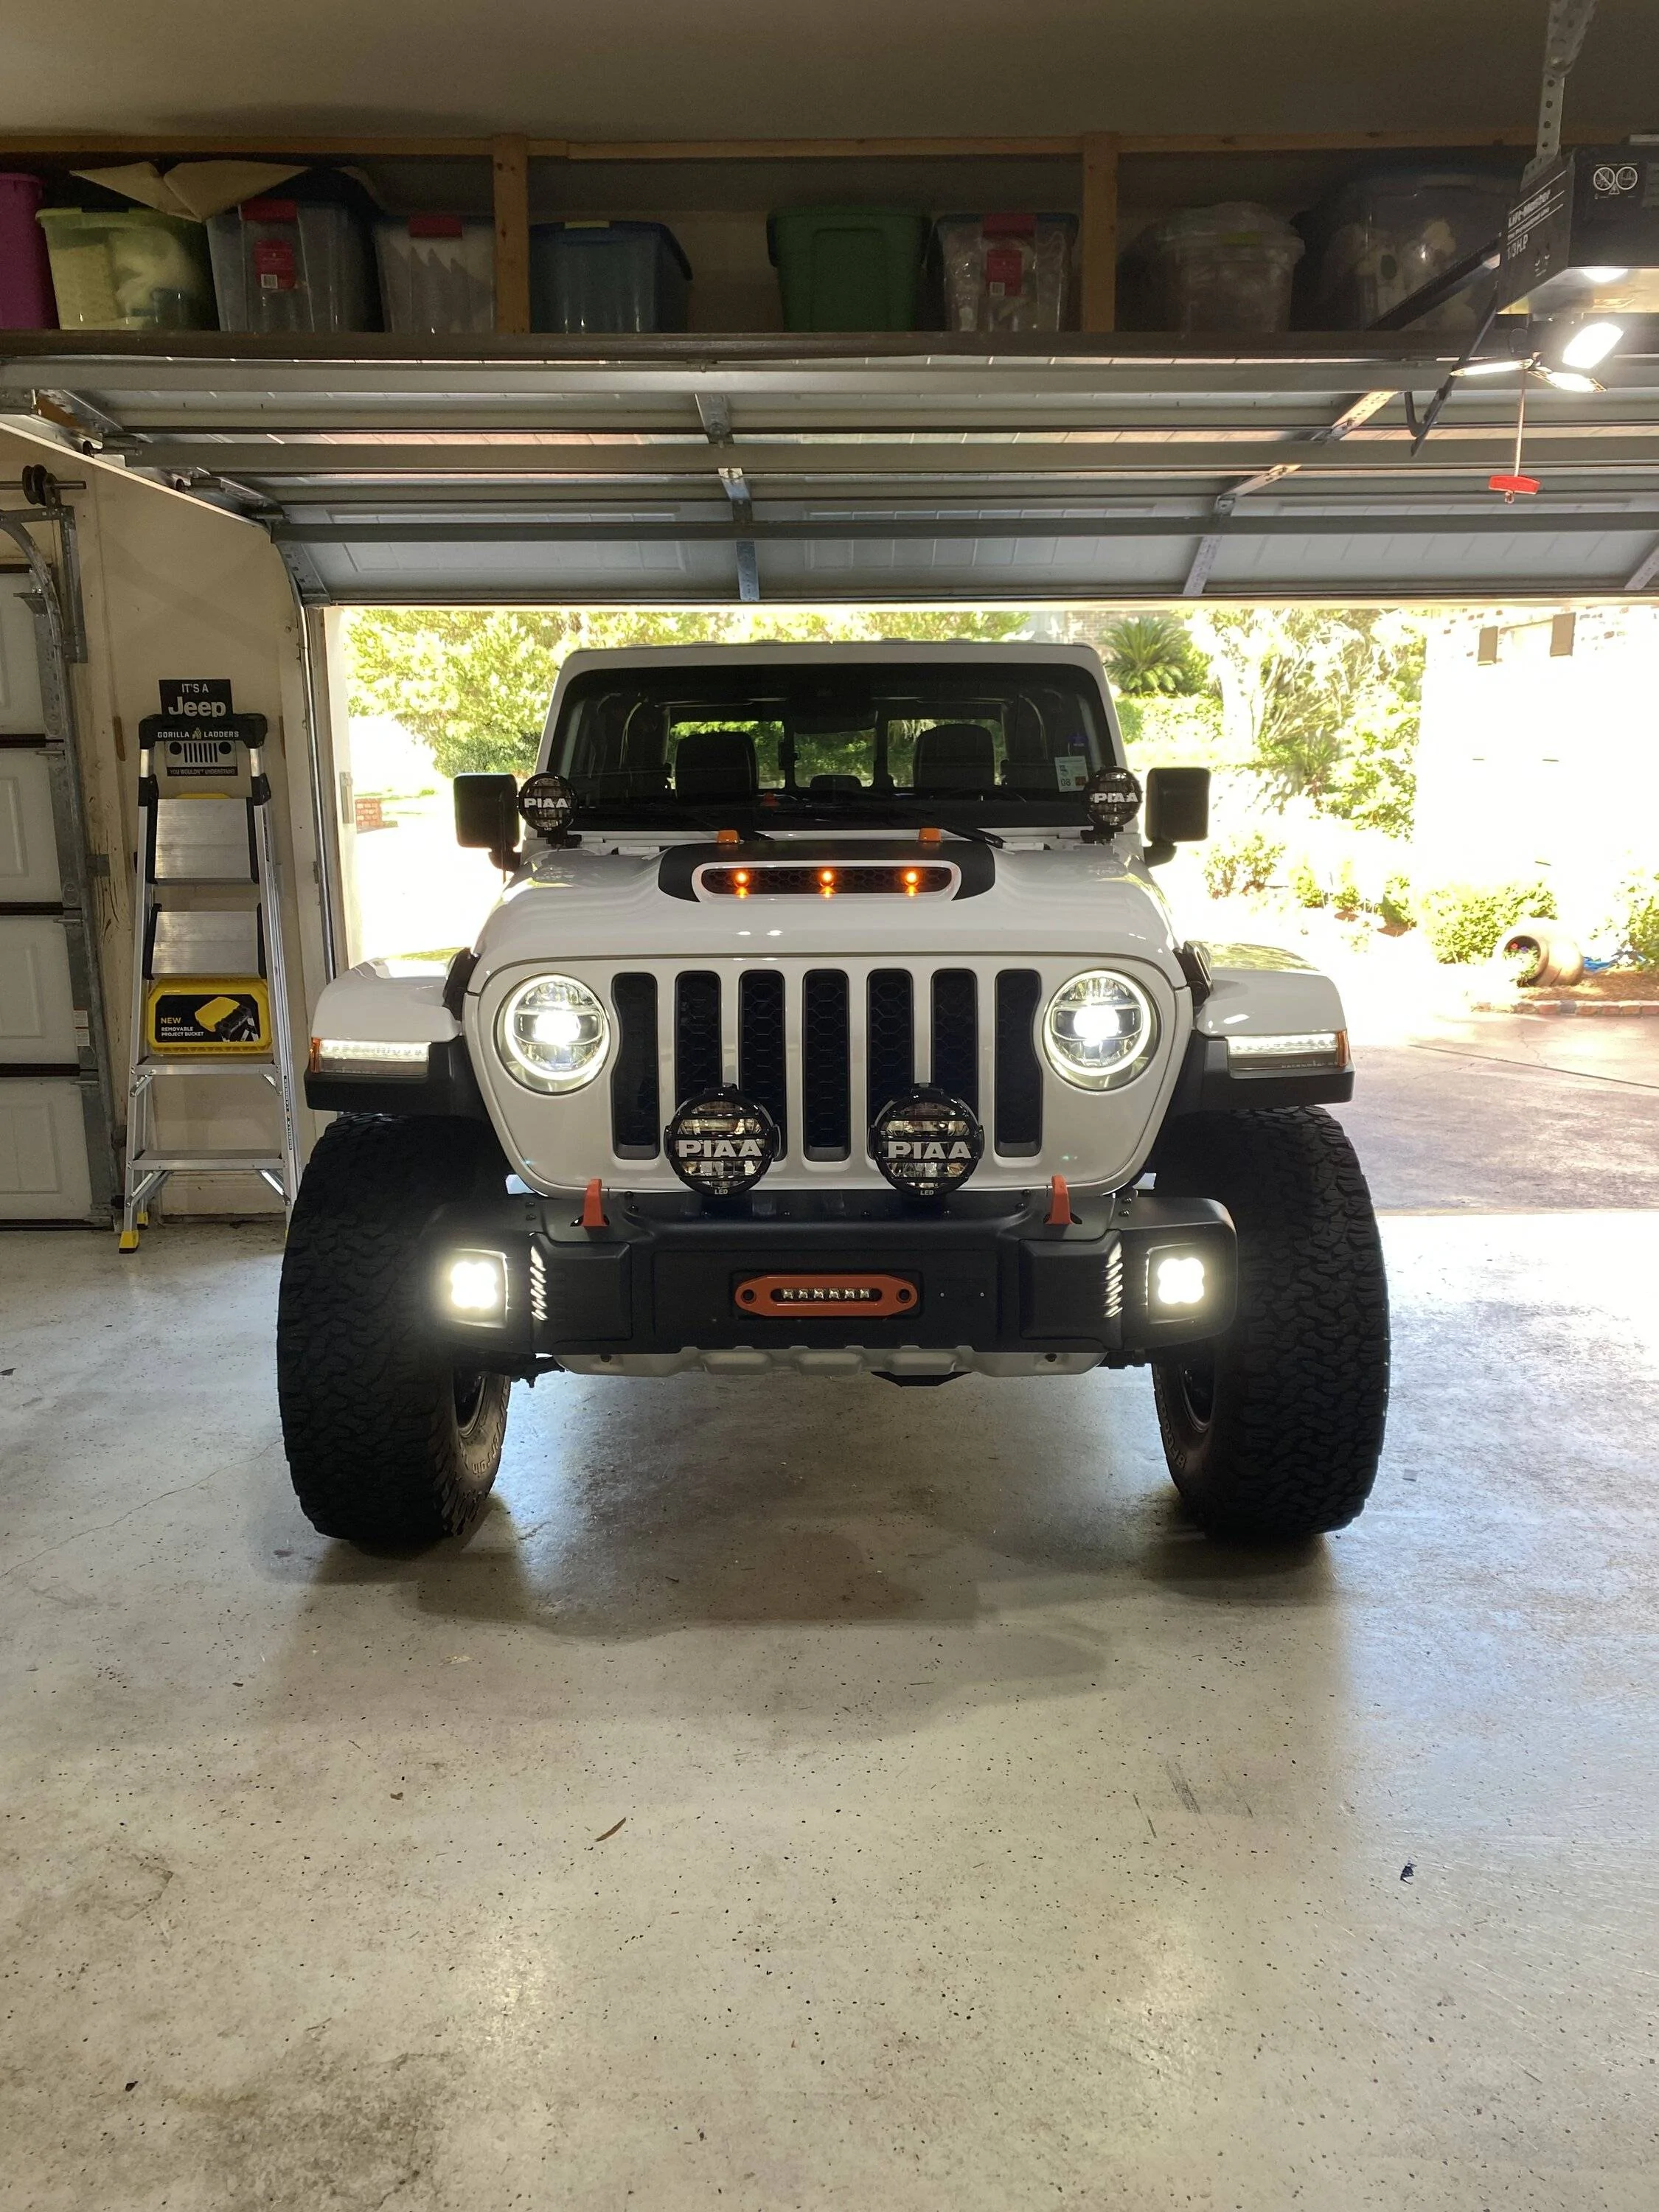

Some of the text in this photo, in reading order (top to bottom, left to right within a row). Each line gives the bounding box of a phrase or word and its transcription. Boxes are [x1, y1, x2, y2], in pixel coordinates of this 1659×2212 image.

[181, 684, 209, 693] IT'S A
[168, 696, 226, 717] Jeep
[524, 798, 568, 808] PIAA
[1094, 793, 1138, 803] PIAA
[678, 1140, 762, 1158] PIAA
[888, 1141, 972, 1159] PIAA
